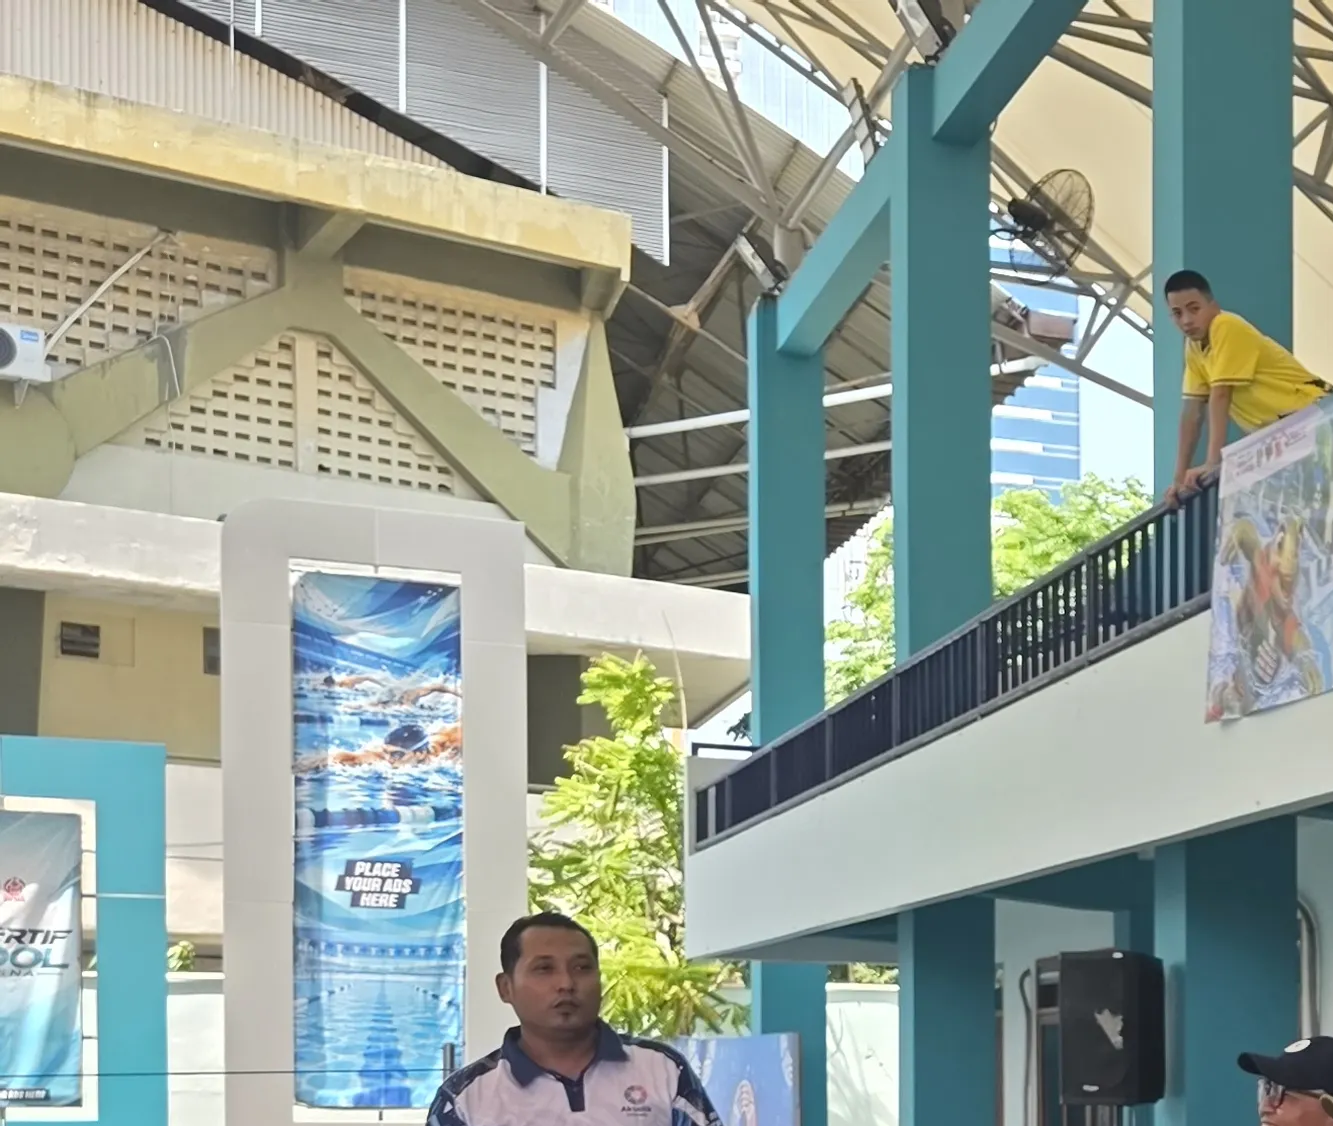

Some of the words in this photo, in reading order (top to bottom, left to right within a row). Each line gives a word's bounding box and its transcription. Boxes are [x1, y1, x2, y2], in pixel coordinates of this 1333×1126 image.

[354, 861, 401, 877] PLACE
[345, 876, 382, 892] YOUR
[382, 878, 412, 893] ADS
[360, 892, 399, 908] HERE
